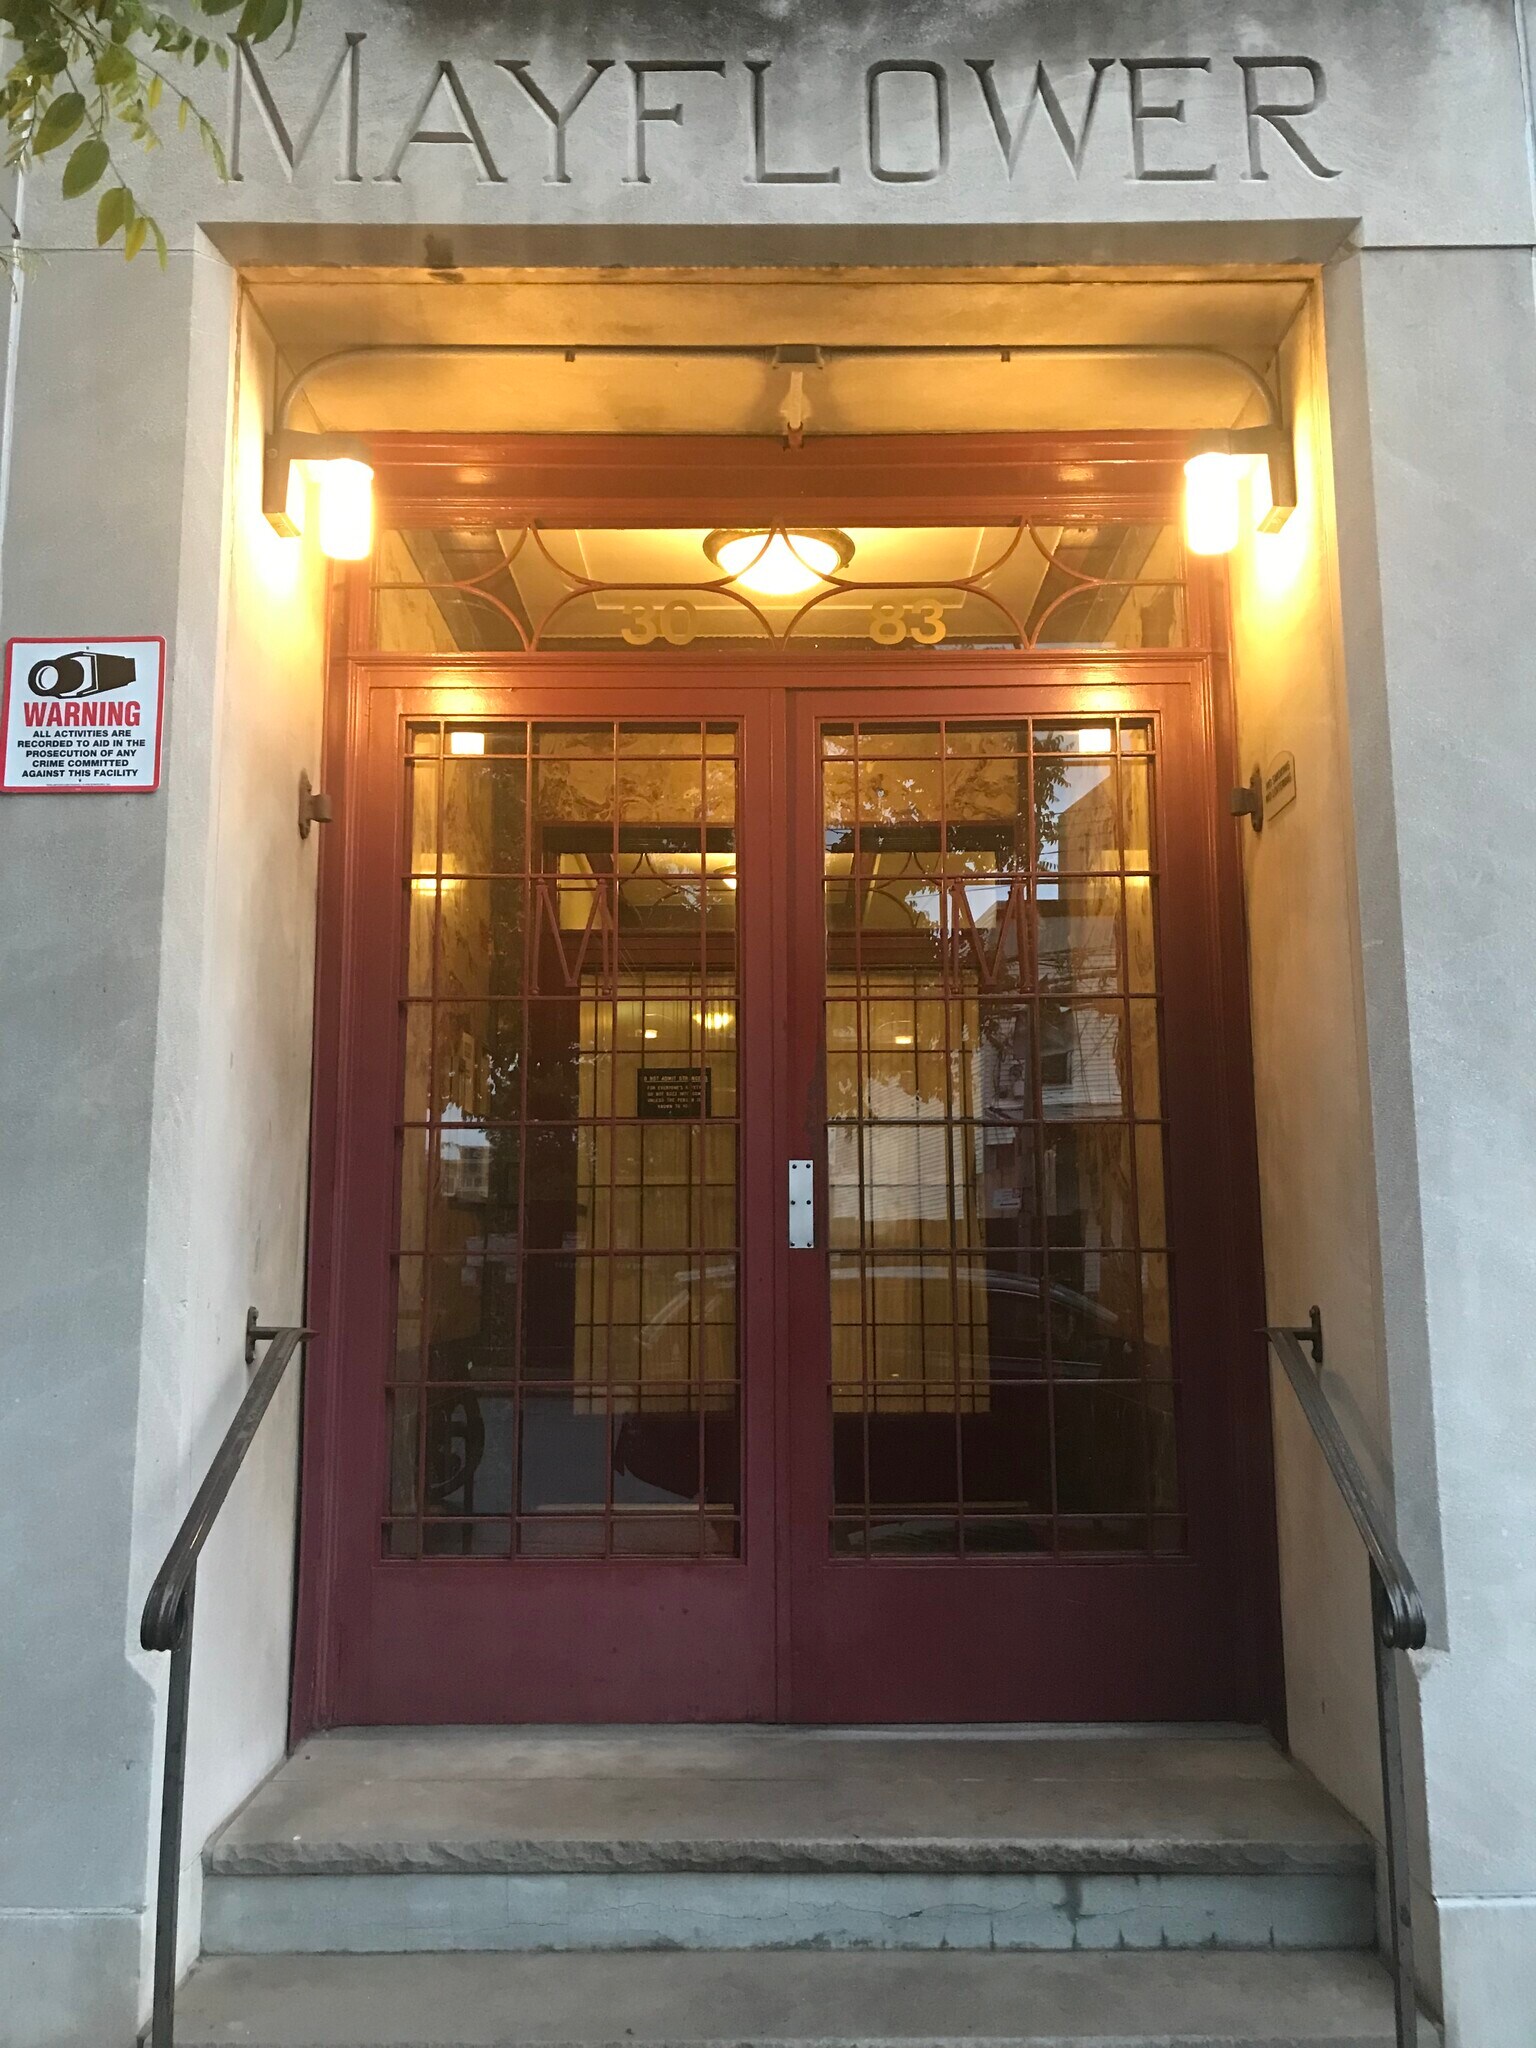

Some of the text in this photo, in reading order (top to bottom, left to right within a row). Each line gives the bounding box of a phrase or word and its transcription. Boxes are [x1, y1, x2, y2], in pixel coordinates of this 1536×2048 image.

[222, 31, 1342, 187] MAYFLOWER
[620, 598, 947, 645] 30 83
[24, 701, 140, 727] WARNING
[111, 729, 132, 737] ARE
[17, 740, 74, 748] RECORDED
[113, 739, 123, 747] IN
[126, 739, 146, 747] THE
[100, 749, 113, 757] OF
[116, 749, 137, 757] ANY
[67, 759, 129, 767] COMMITTED
[21, 769, 139, 777] AGAINST THIS FACILITY
